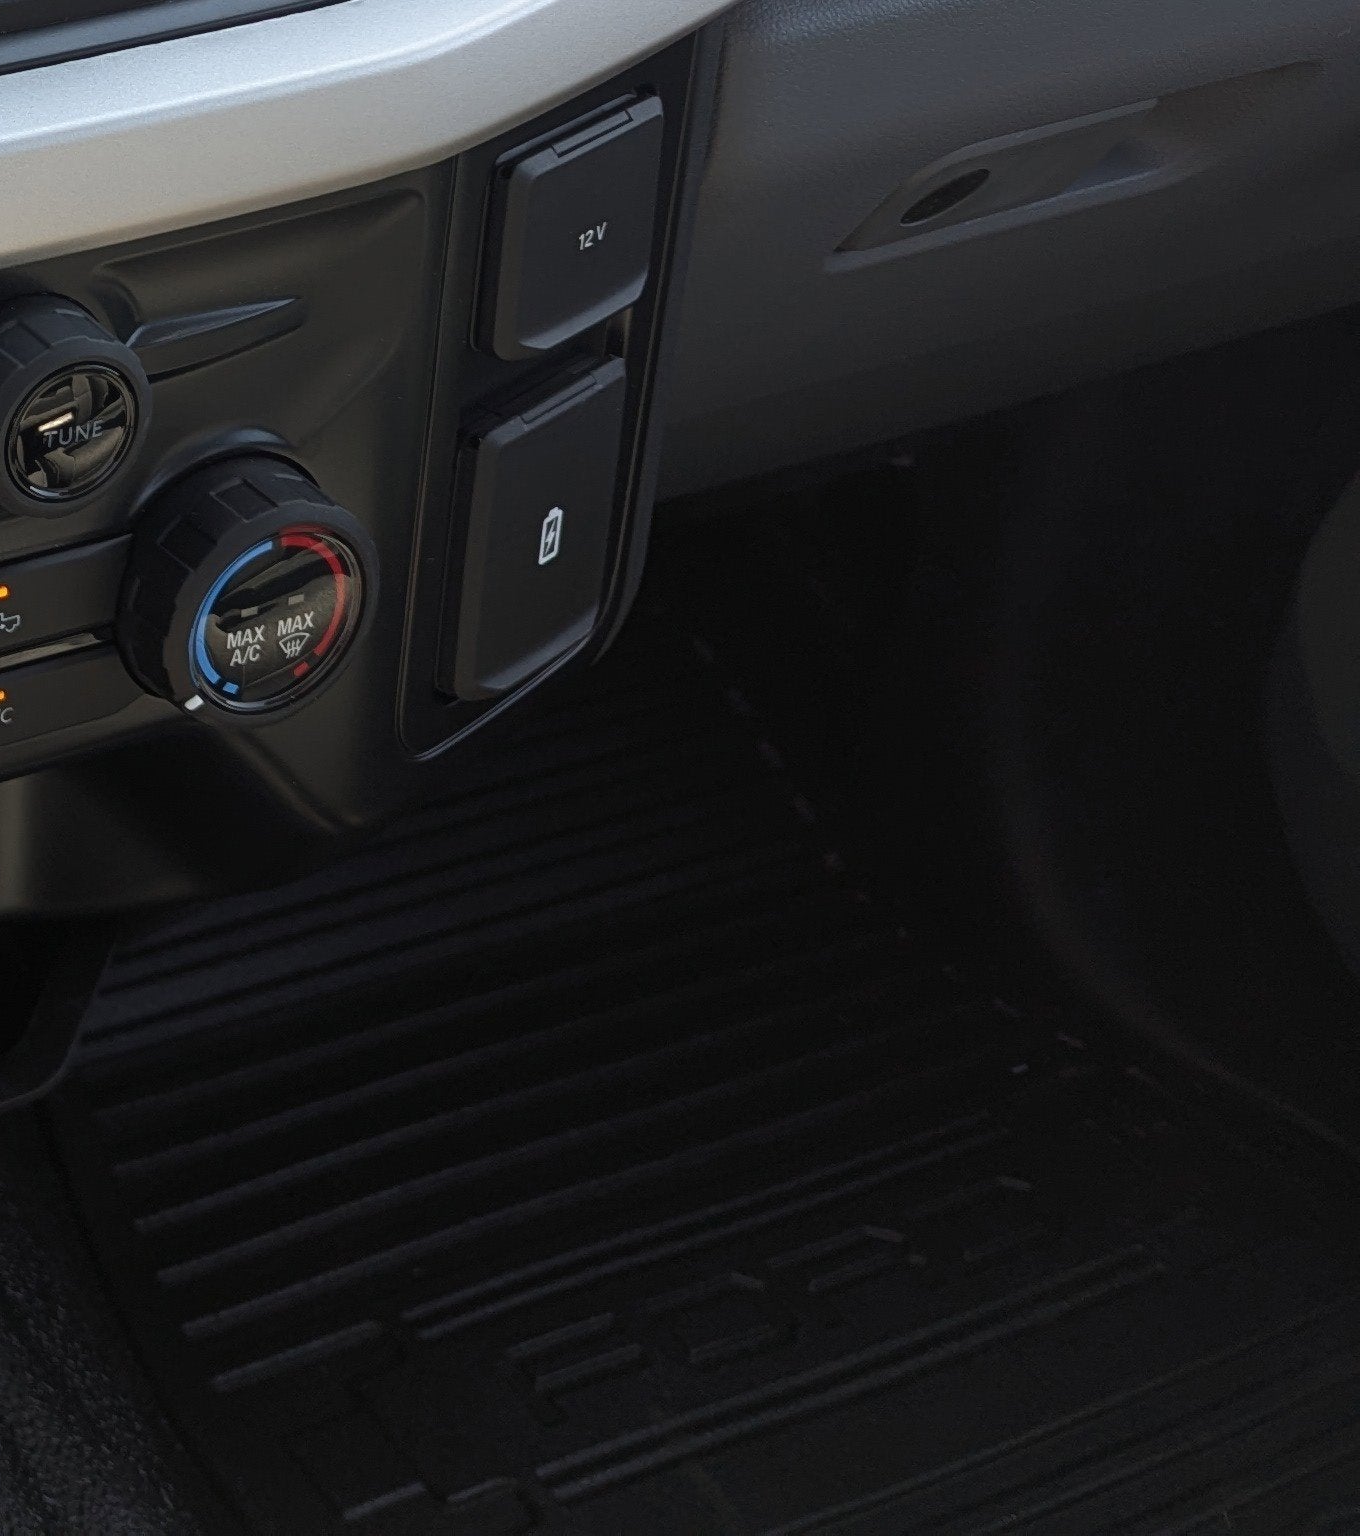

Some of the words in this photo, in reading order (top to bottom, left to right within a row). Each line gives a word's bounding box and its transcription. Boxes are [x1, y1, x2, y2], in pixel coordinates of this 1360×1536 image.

[578, 227, 594, 252] 12
[595, 222, 608, 242] V
[42, 420, 104, 448] TUNE
[276, 611, 316, 636] MAX
[227, 625, 266, 651] MAX
[230, 643, 262, 668] A/C
